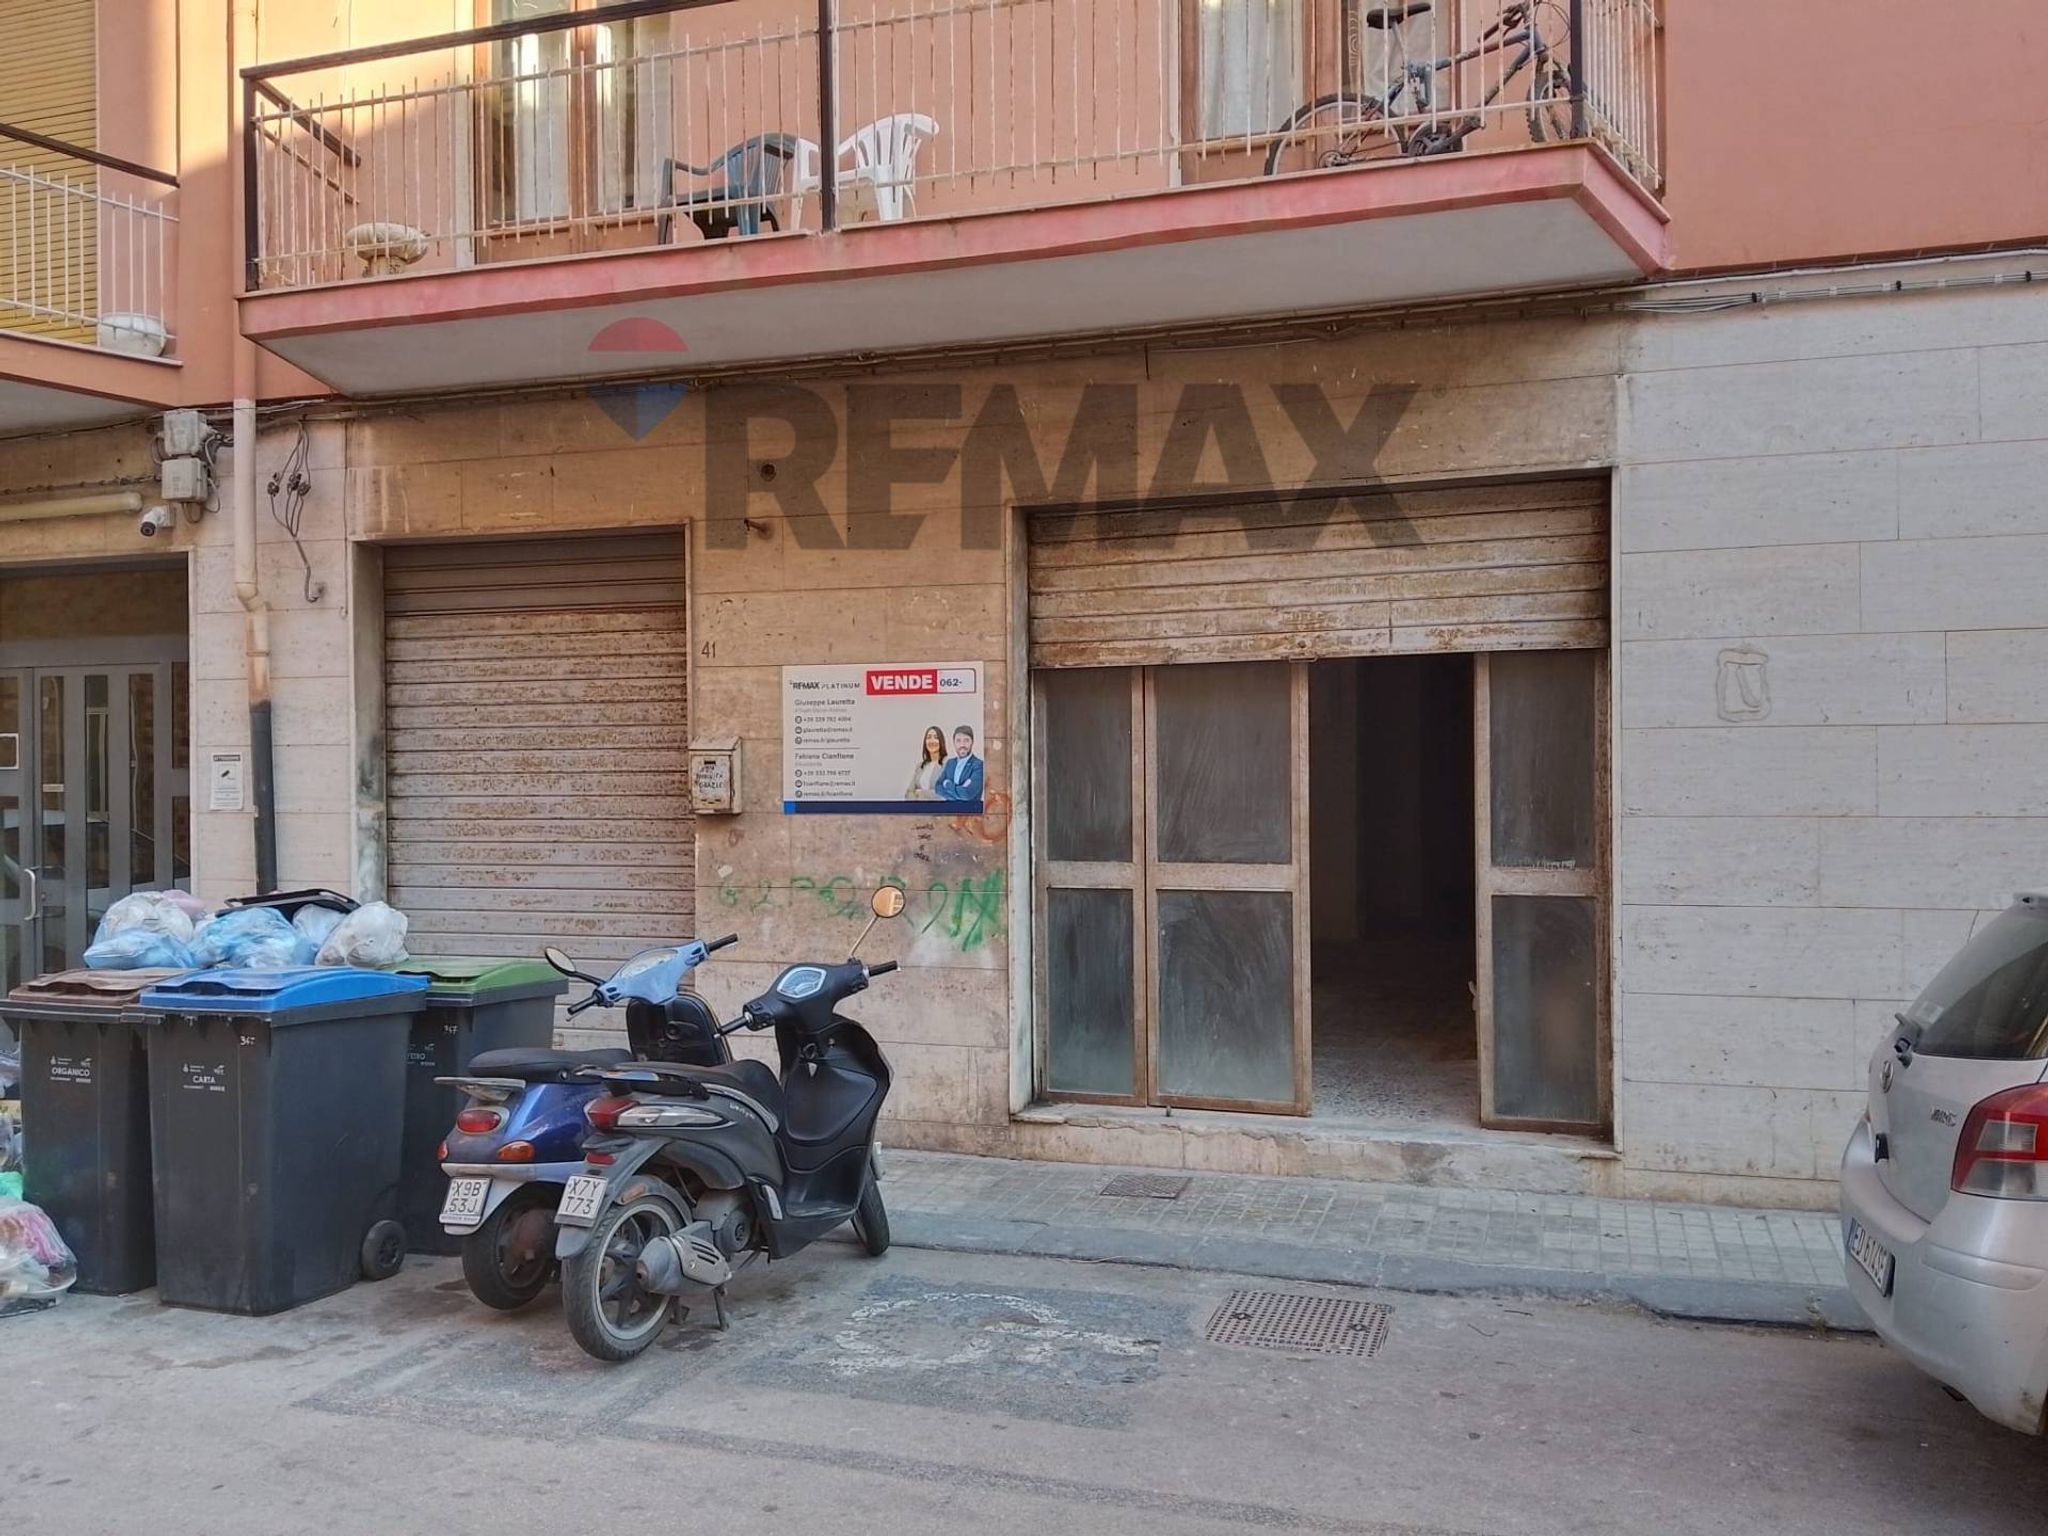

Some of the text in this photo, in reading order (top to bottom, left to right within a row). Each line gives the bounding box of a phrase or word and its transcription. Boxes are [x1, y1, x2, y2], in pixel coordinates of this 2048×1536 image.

[700, 640, 717, 659] 41
[821, 682, 861, 690] PLATINUM
[870, 674, 933, 691] VENDE
[794, 698, 825, 706] Giuseppe
[51, 1066, 91, 1077] ORGANICO
[192, 1075, 217, 1084] CARTA
[452, 1181, 482, 1197] X9B
[568, 1178, 601, 1196] X7Y
[448, 1197, 478, 1214] 53J
[563, 1195, 595, 1215] T73
